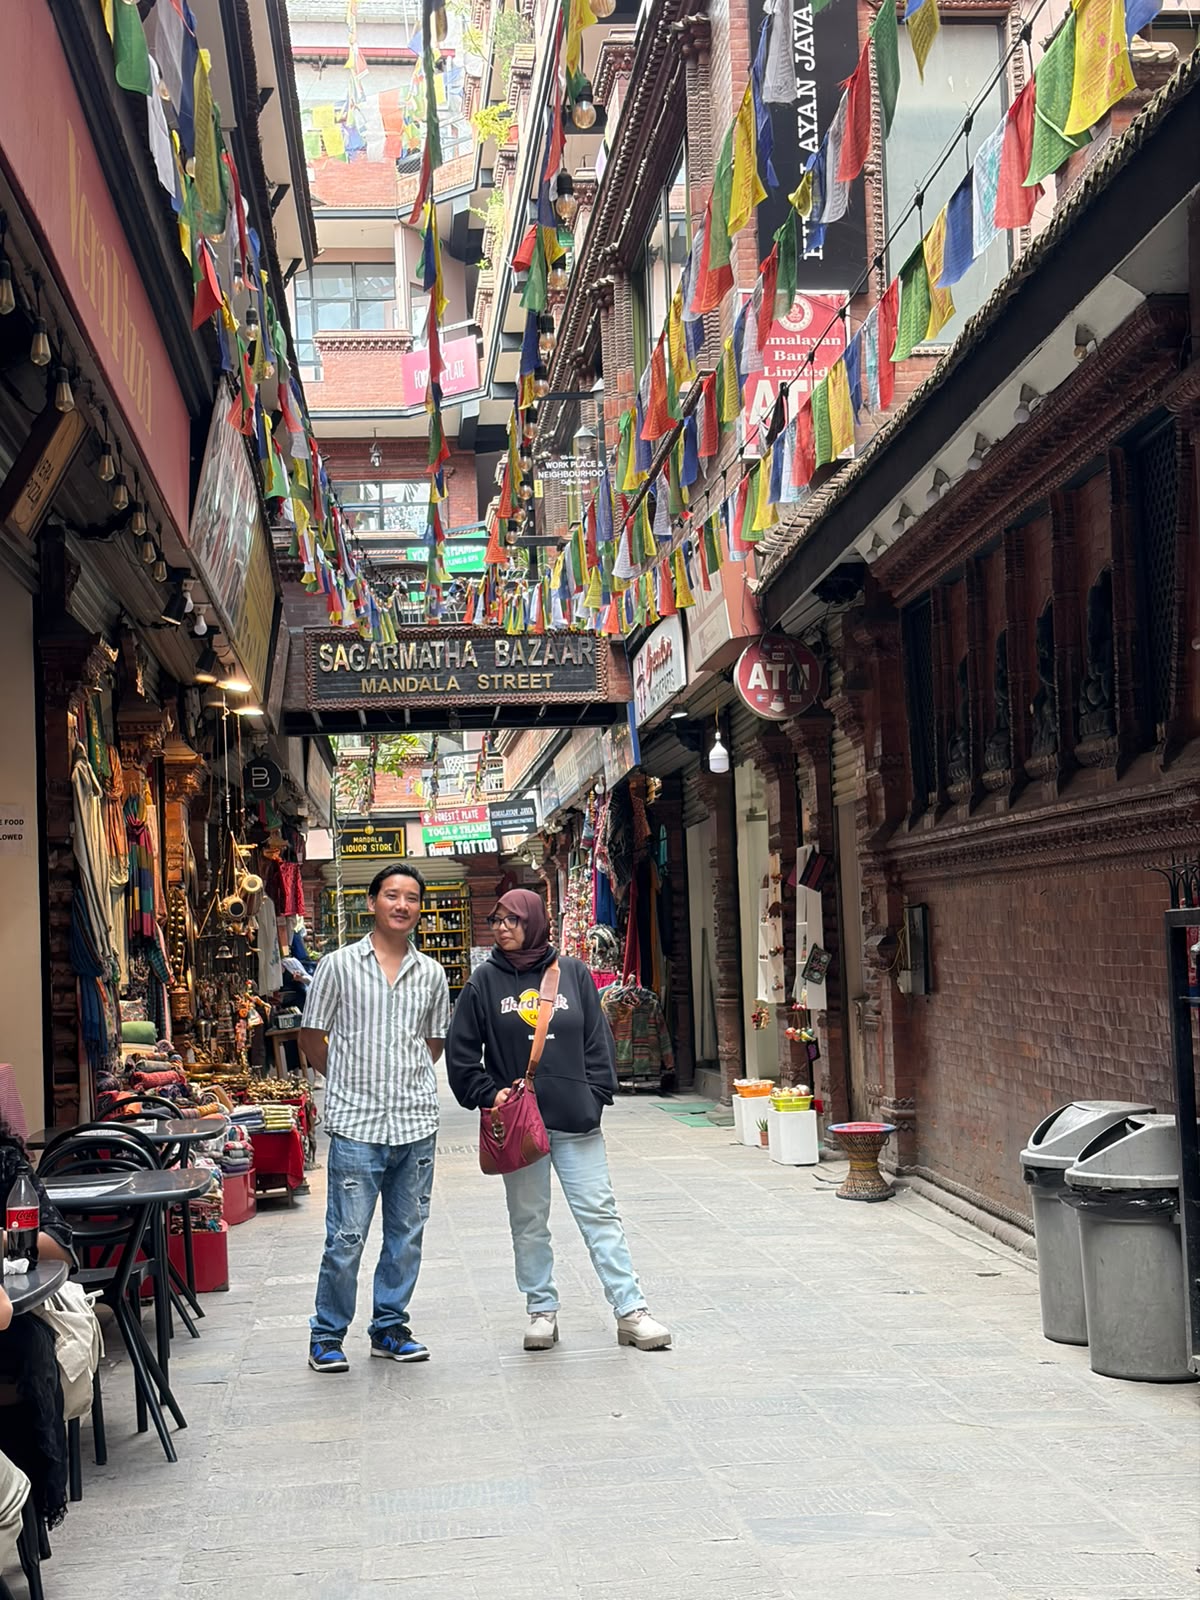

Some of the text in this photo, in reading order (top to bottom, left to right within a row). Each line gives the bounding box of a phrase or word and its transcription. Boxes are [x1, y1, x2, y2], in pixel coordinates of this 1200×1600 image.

[793, 3, 815, 71] JAVA
[66, 119, 152, 435] Vera Pizza
[764, 366, 828, 377] Limited
[750, 380, 822, 425] AT
[545, 461, 569, 469] WORK
[319, 637, 594, 673] SAGARMATHA BAZAAR
[361, 672, 554, 694] MANDALA STREET
[461, 809, 479, 820] PLATE
[427, 827, 451, 837] YOGA
[341, 843, 392, 853] LIQUOR STORE
[455, 838, 498, 855] TATTOO
[501, 996, 534, 1013] Hard
